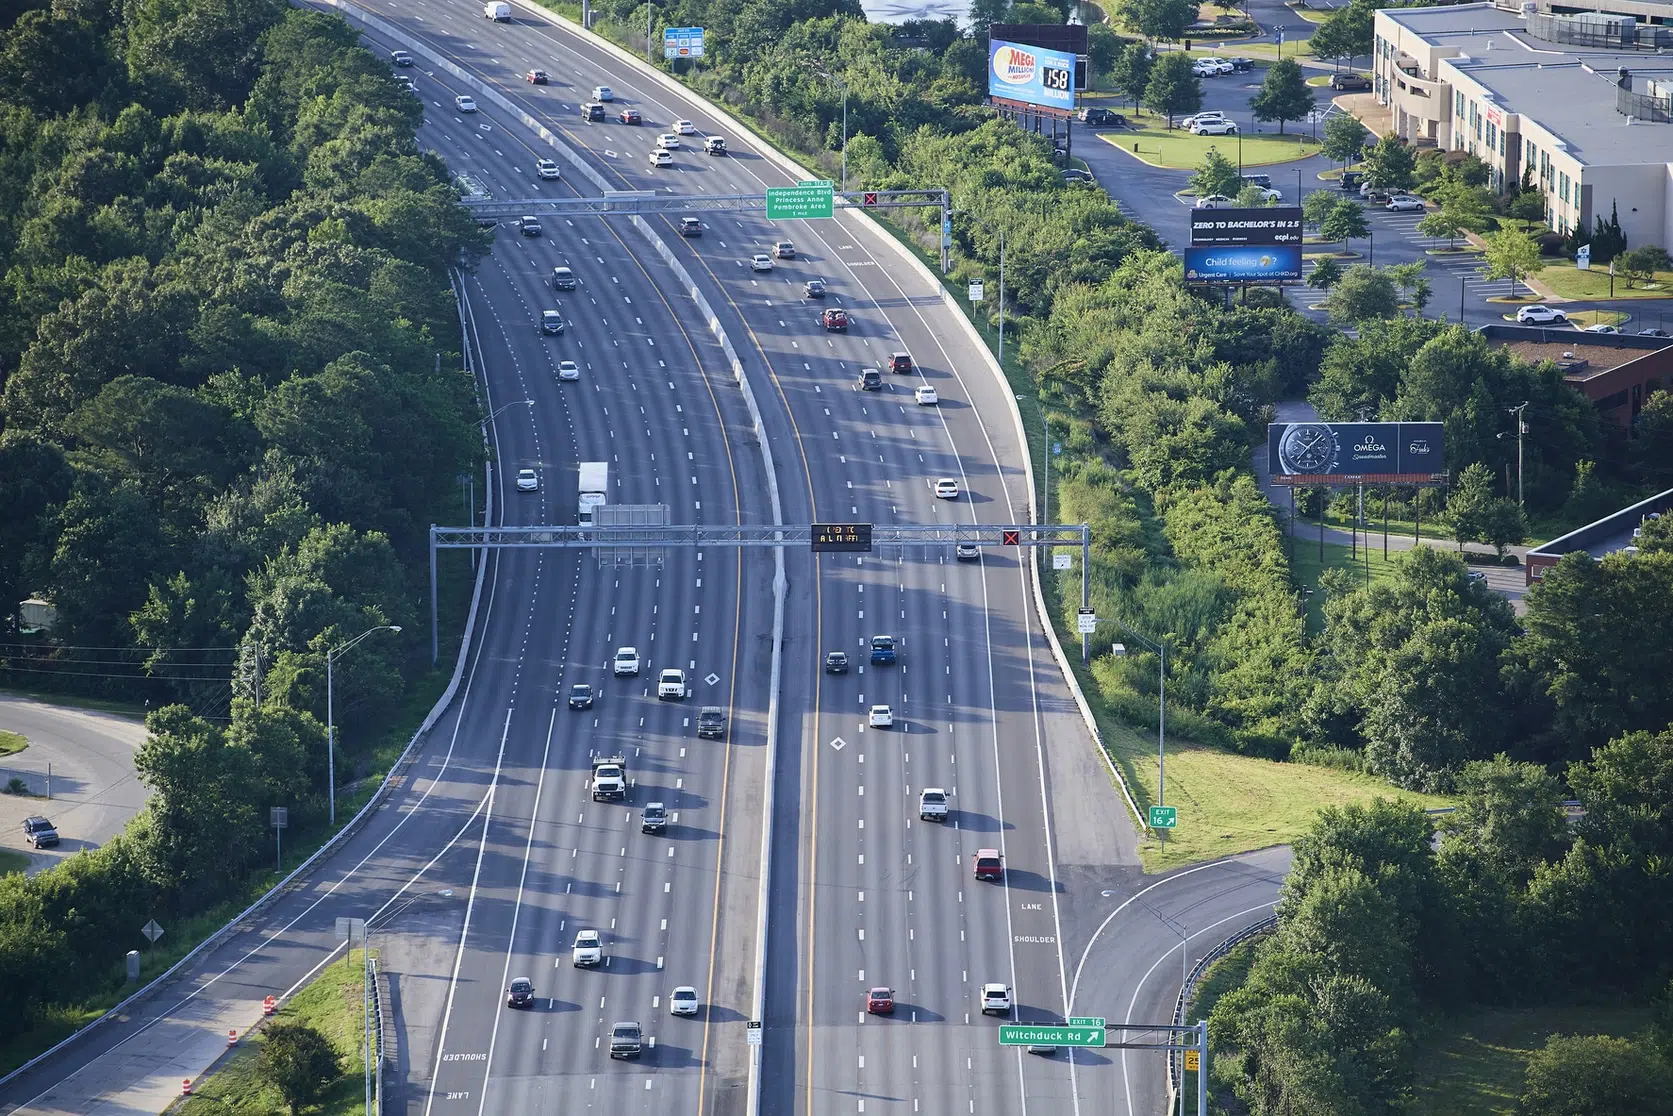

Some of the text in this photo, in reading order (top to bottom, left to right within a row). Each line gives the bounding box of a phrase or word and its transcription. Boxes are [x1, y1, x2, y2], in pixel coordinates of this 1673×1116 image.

[1009, 49, 1034, 66] MEGA
[1044, 87, 1069, 100] MILLION
[1193, 220, 1300, 229] ZERO TO BACHELOR'S IN 2.5
[1205, 258, 1227, 266] Child
[1228, 257, 1257, 267] feeling
[1353, 444, 1386, 452] OMEGA
[1153, 816, 1163, 825] 16
[1014, 935, 1056, 943] SHOULDER
[1005, 1031, 1081, 1041] Witchduck Rd
[442, 1053, 487, 1061] SHOULDER
[446, 1091, 469, 1100] LANE
